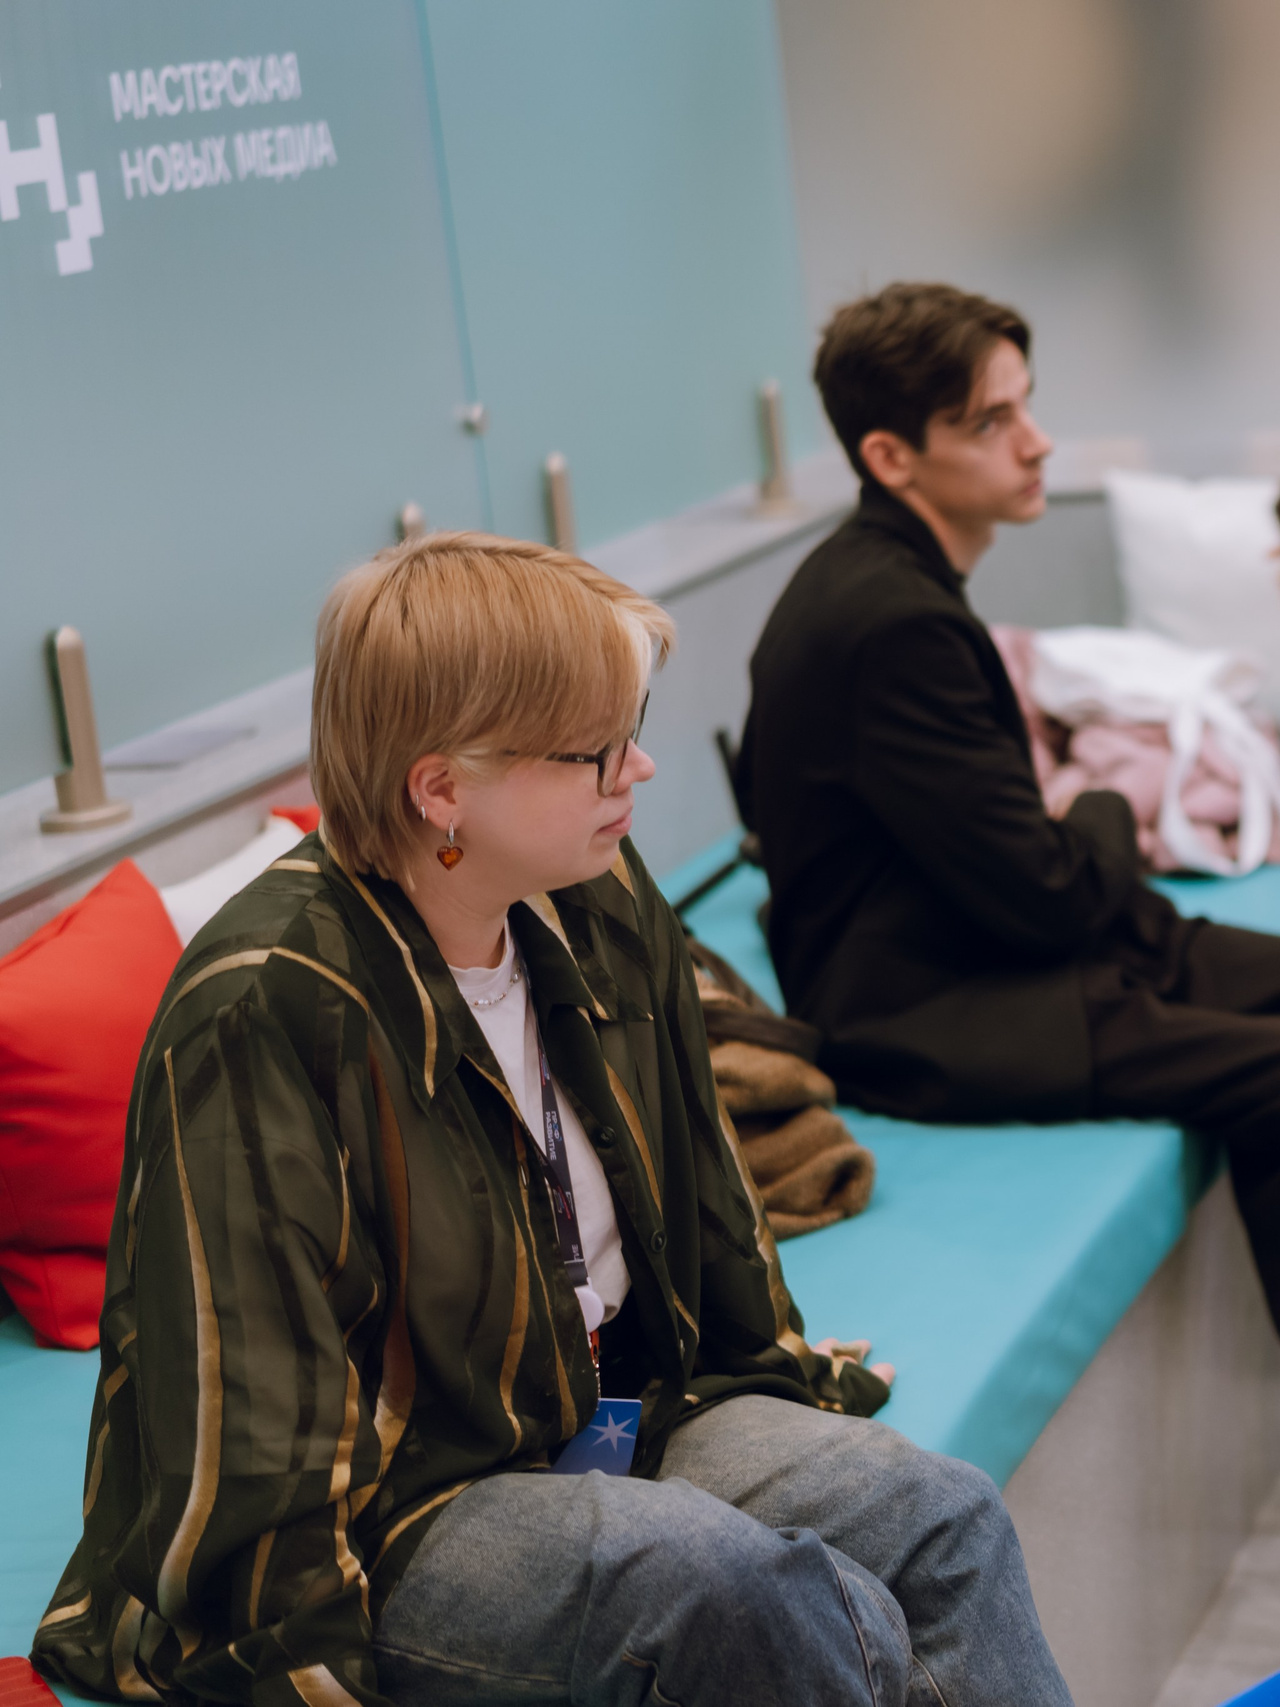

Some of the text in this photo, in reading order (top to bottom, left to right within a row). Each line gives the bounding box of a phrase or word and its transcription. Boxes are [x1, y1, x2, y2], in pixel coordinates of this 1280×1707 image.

[109, 52, 301, 122] МАСТЕРСКАЯ
[120, 120, 338, 200] НОВЫХ МЕДИА
[545, 1111, 557, 1160] РАЗВИТИЕ
